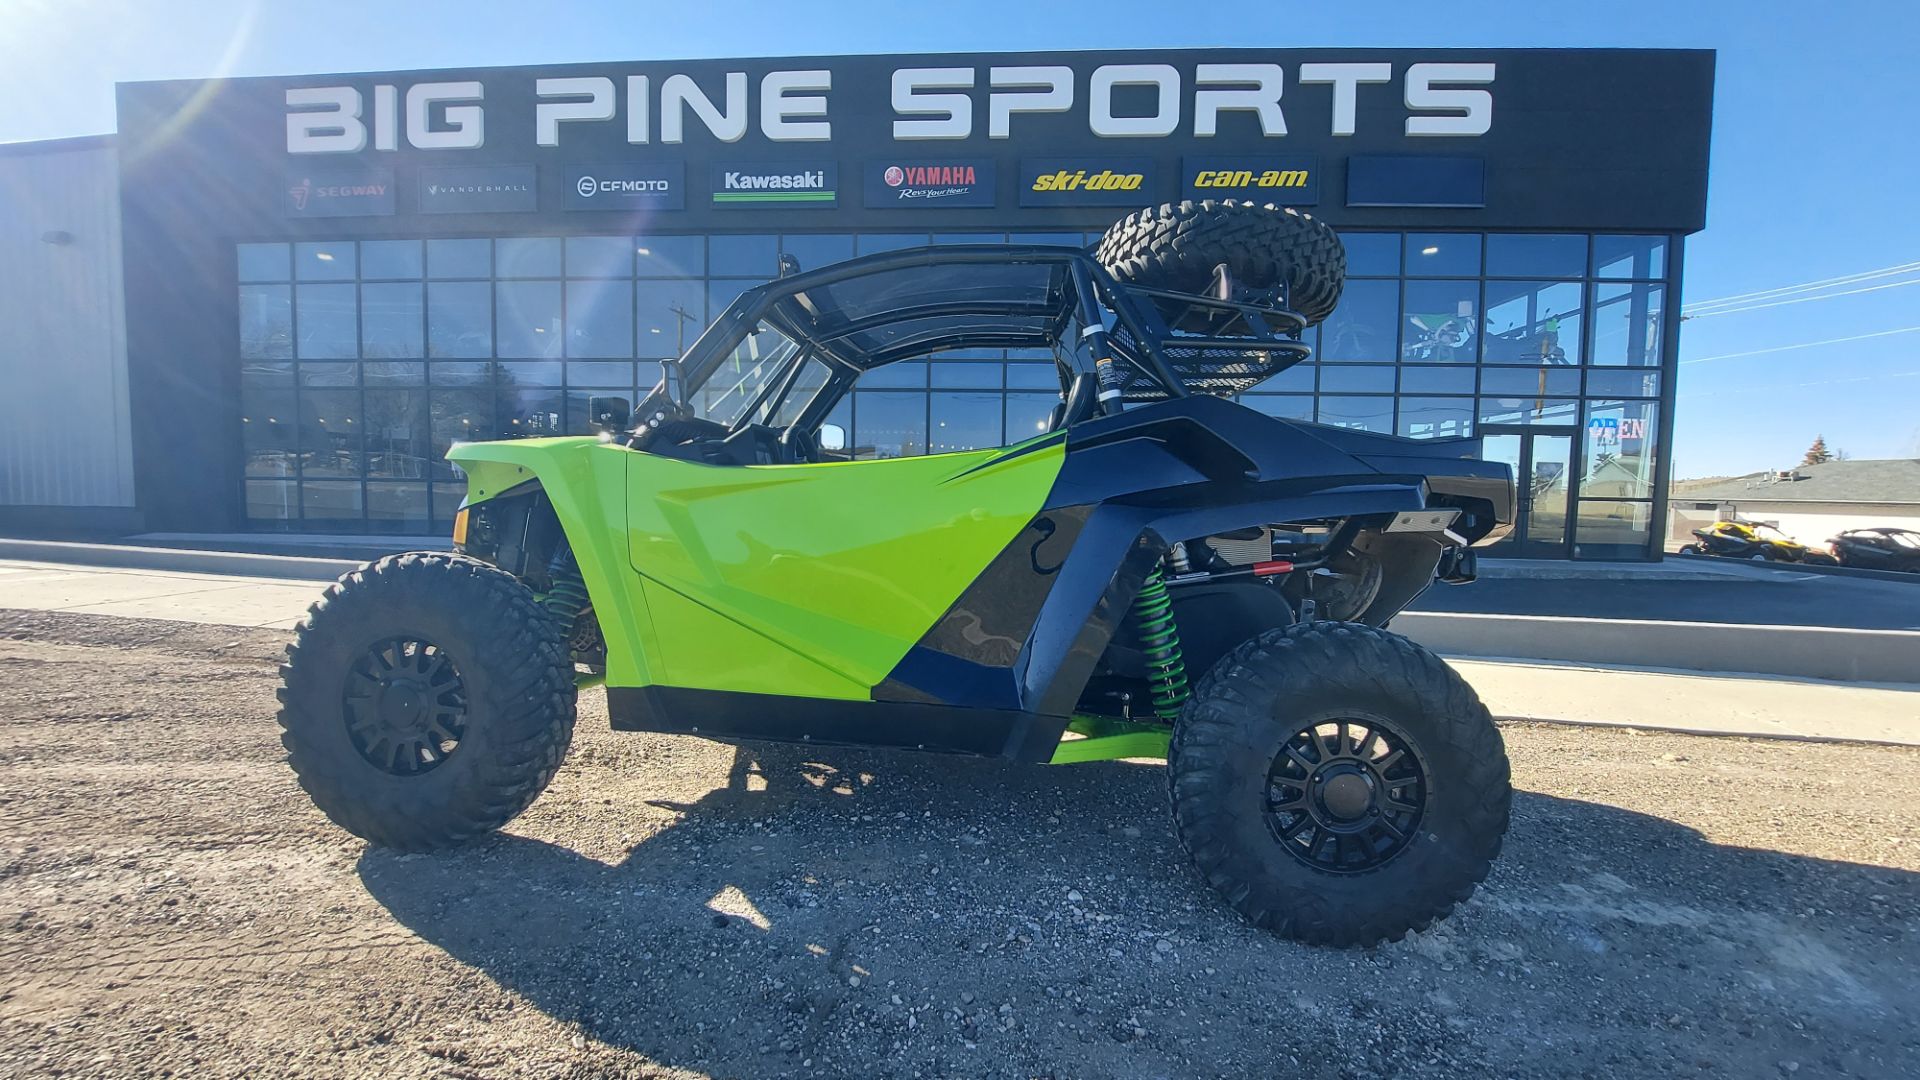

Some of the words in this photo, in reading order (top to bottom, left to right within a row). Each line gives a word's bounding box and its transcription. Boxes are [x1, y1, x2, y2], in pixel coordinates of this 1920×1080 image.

[285, 80, 484, 154] BIG
[536, 70, 832, 147] PINE
[891, 62, 1496, 140] SPORTS
[724, 171, 824, 189] Kawasaki
[905, 166, 976, 186] YAMAHA
[1032, 170, 1143, 191] ski-doo
[1194, 169, 1308, 188] can-am
[316, 184, 386, 198] SEGWAY
[440, 184, 528, 194] VANDERHALL
[600, 180, 669, 192] CFMOTO
[898, 188, 927, 200] Revs
[926, 188, 948, 198] Your
[947, 187, 969, 196] Heart
[1588, 418, 1646, 439] OPEN
